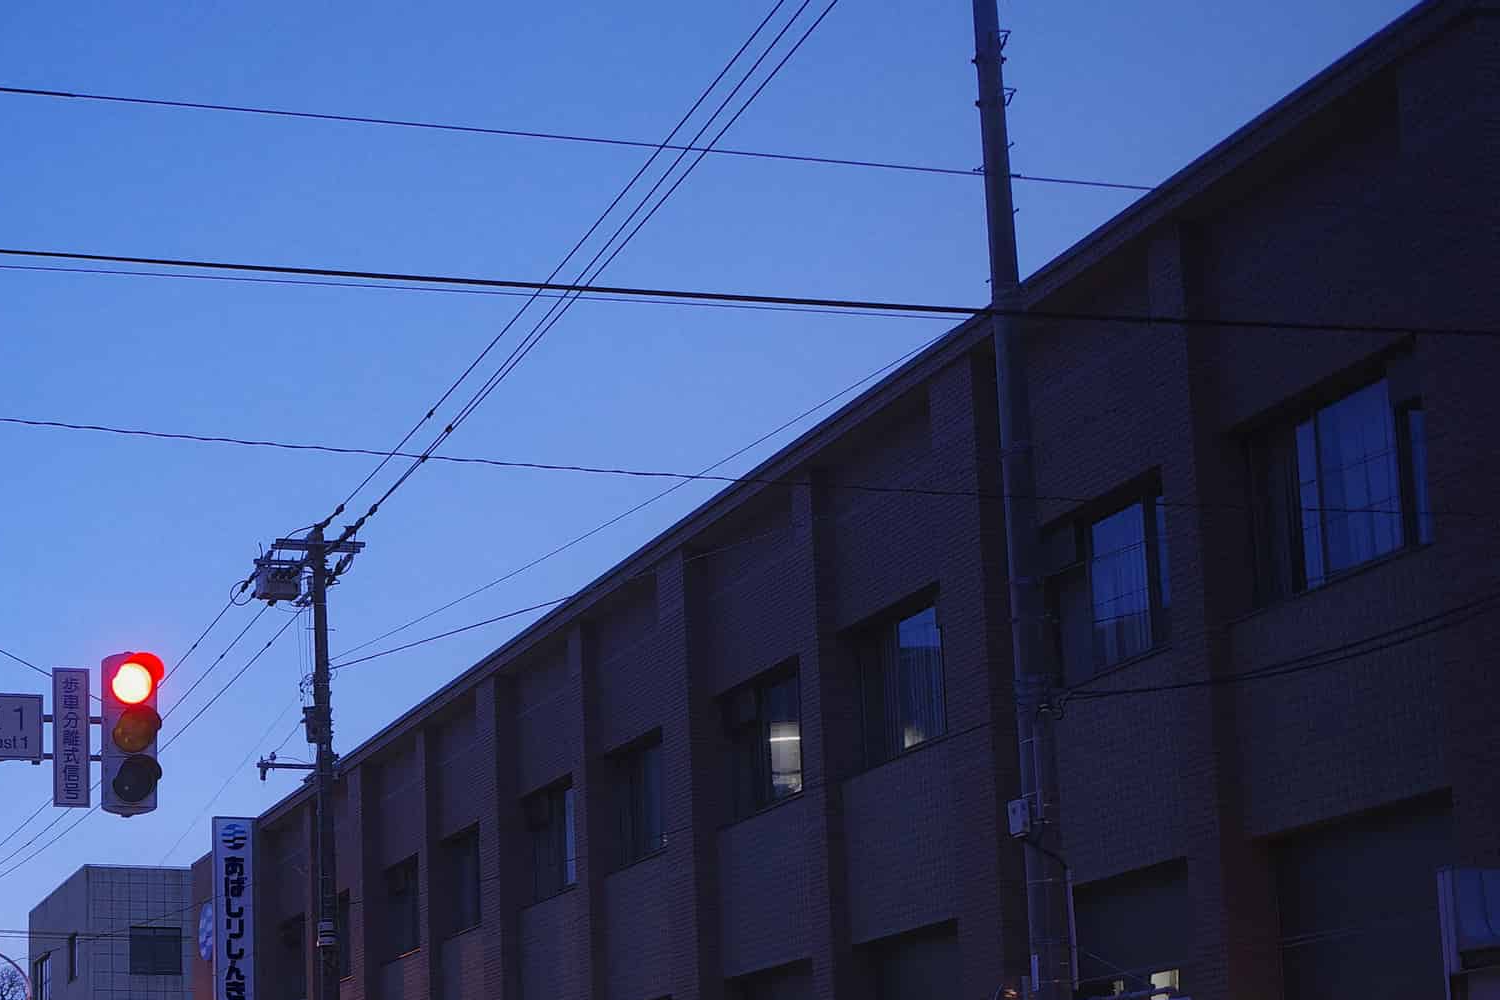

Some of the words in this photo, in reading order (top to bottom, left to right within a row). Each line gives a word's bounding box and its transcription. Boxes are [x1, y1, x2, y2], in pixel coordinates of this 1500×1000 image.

[62, 677, 81, 800] 歩車分離式信号
